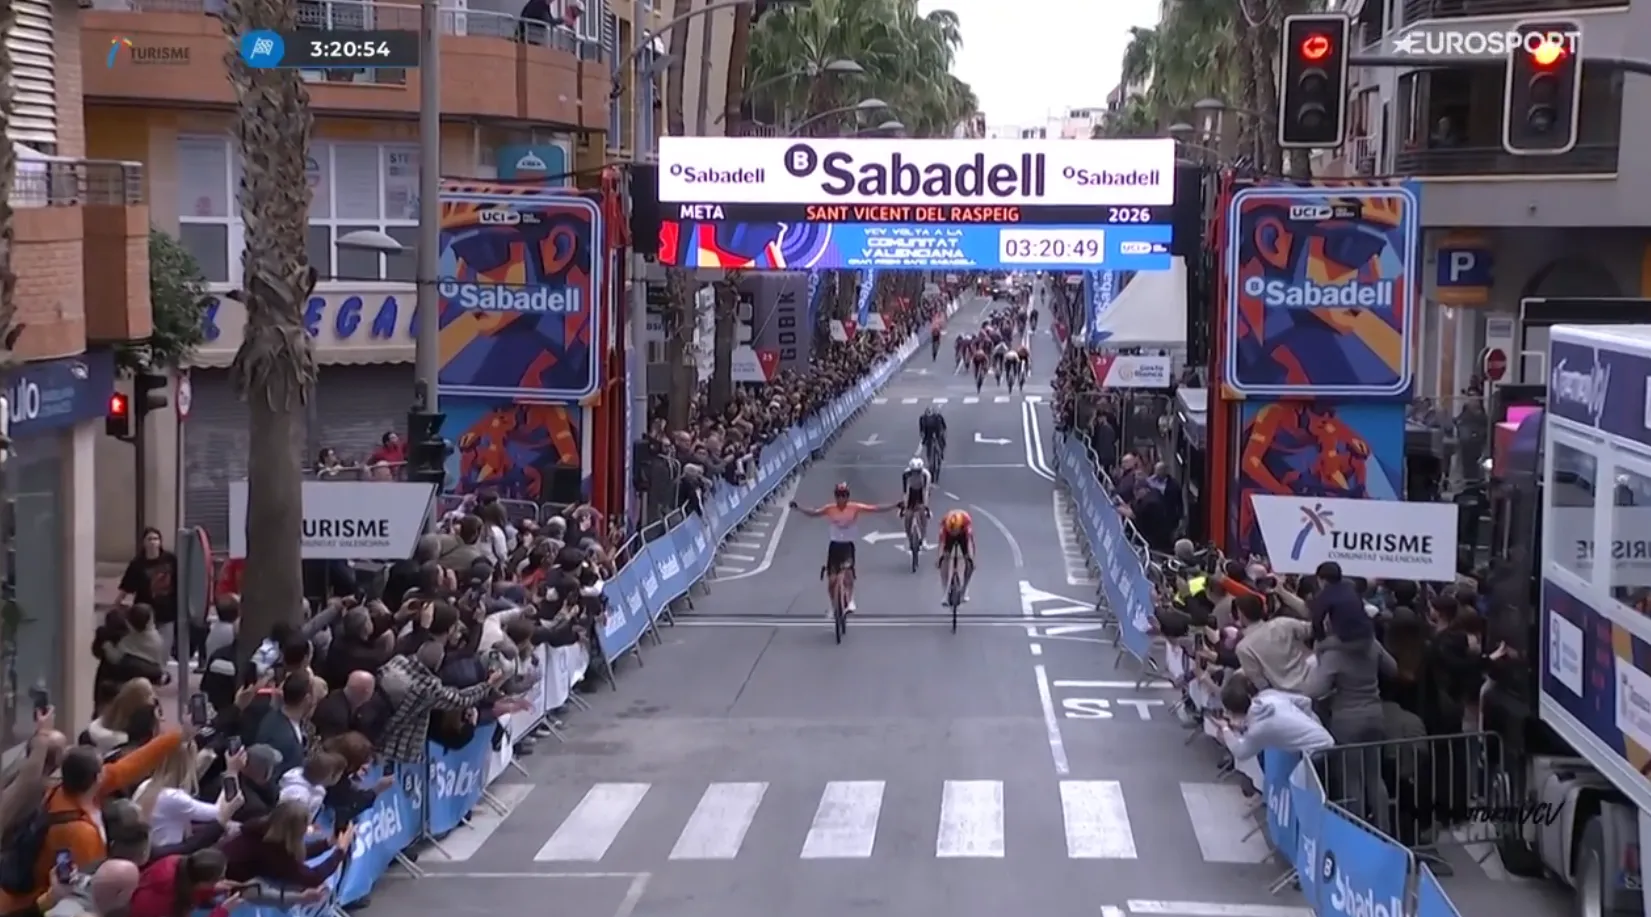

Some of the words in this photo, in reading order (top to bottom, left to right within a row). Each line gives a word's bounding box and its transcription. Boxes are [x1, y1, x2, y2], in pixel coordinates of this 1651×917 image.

[684, 167, 765, 183] Sabadell
[821, 151, 1045, 197] Sabadell
[1077, 169, 1159, 186] Sabadell
[482, 212, 505, 222] UCI
[681, 205, 725, 220] META
[807, 206, 849, 220] SANT
[853, 207, 911, 221] VICENT
[915, 207, 946, 221] DEL
[952, 207, 1020, 222] RASPEIG
[1109, 208, 1151, 223] 2026
[1293, 207, 1317, 217] UCI
[867, 238, 959, 247] COMUNITAT
[1005, 239, 1099, 257] 03:20:49
[862, 248, 964, 258] VALENCIANA
[1450, 251, 1475, 281] P
[459, 284, 580, 311] Sabadell
[1265, 280, 1392, 306] Sabadell
[778, 291, 797, 361] GOBIK
[302, 518, 390, 538] URISME
[1330, 531, 1434, 554] TURISME
